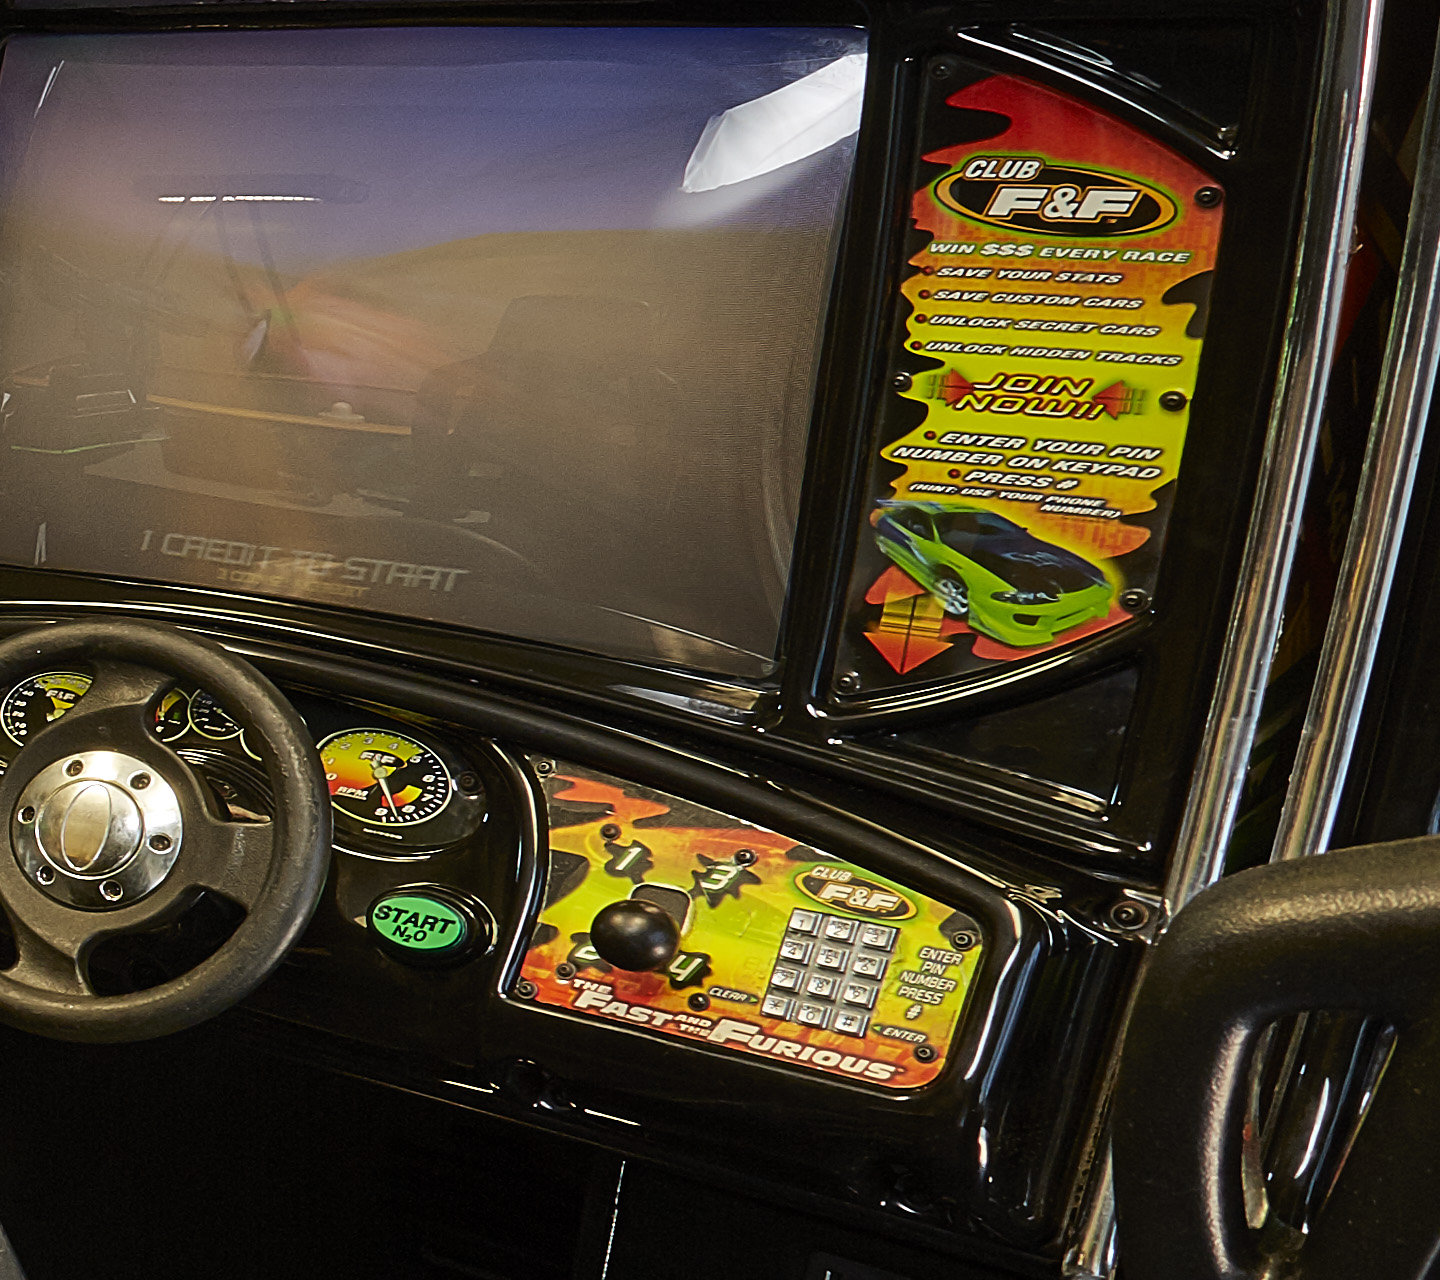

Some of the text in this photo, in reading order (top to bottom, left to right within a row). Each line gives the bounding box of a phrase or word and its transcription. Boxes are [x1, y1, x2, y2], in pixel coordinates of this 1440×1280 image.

[965, 160, 1040, 179] CLUB
[988, 187, 1137, 219] F&F
[930, 243, 1190, 263] WIN $$$ EVERY RACE
[937, 267, 1123, 284] SAVE YOUR STATS
[933, 290, 1143, 309] SAVE CUSTOM CARS
[930, 315, 1160, 336] UNLOCK SECRET CARS
[925, 342, 1182, 366] UNLOCK HIDDEN TRACKS
[973, 374, 1093, 396] JOIN
[956, 393, 1104, 419] NOW!!
[940, 432, 1160, 460] ENTER YOUR PIN
[893, 446, 1160, 479] NUMBER ON KEYPAD
[965, 471, 1079, 490] PRESS #
[909, 483, 1105, 507] (HINT: USE YOUR PHONE
[1041, 504, 1121, 519] NUMBER)
[161, 532, 283, 570] CREDIT
[341, 557, 472, 592] START
[337, 786, 369, 797] RPM
[615, 847, 642, 871] 1
[699, 864, 742, 890] 3
[811, 866, 853, 882] CLUB
[818, 882, 900, 910] F&F
[375, 905, 456, 935] START
[919, 946, 964, 965] ENTER
[921, 963, 946, 976] PIN
[571, 979, 613, 994] THE
[900, 971, 957, 992] NUMBER
[709, 986, 748, 1001] CLEAR
[898, 986, 944, 1005] PRESS
[574, 991, 677, 1027] FAST
[905, 1003, 923, 1019] #
[673, 1014, 712, 1028] AND
[679, 1023, 711, 1038] THE
[882, 1026, 927, 1043] ENTER
[707, 1018, 897, 1080] FURIOUS
